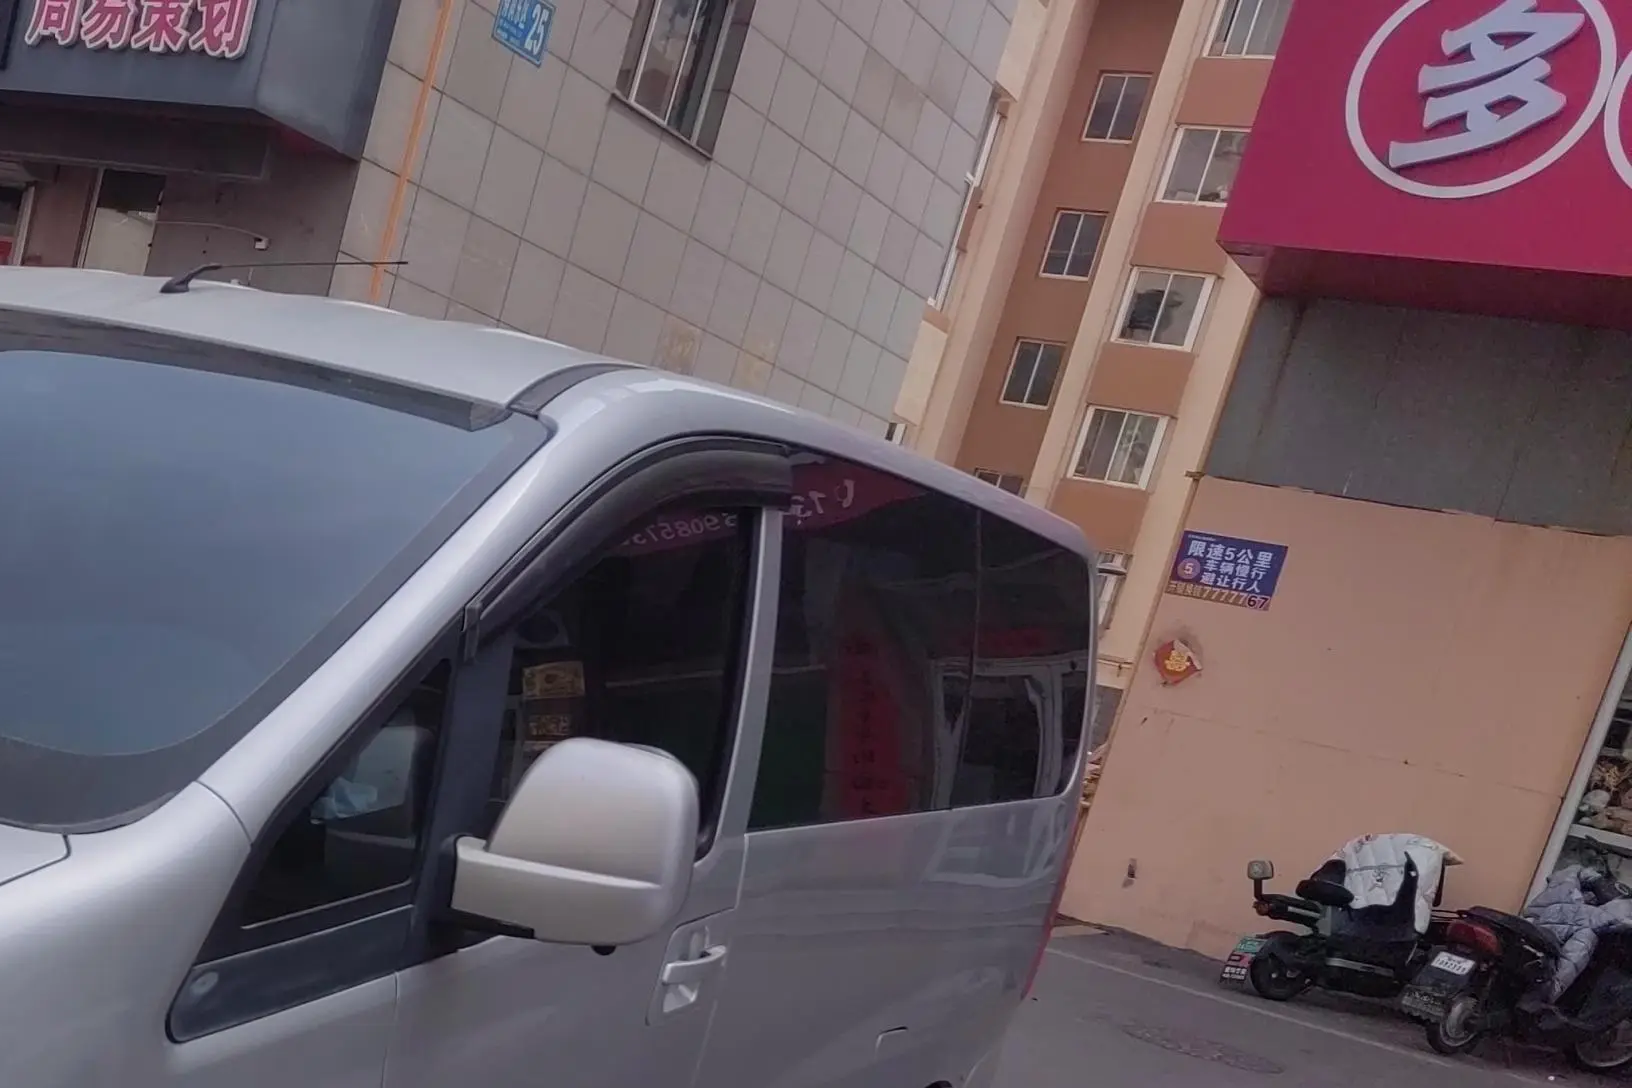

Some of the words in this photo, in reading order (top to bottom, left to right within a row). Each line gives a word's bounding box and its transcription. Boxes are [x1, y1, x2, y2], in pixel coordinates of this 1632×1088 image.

[524, 4, 549, 55] 25
[1389, 0, 1583, 168] 多
[1188, 540, 1273, 568] 限速5公里
[1184, 562, 1194, 575] 5
[1204, 559, 1267, 580] 车辆慢行
[1200, 572, 1260, 593] 避让行人
